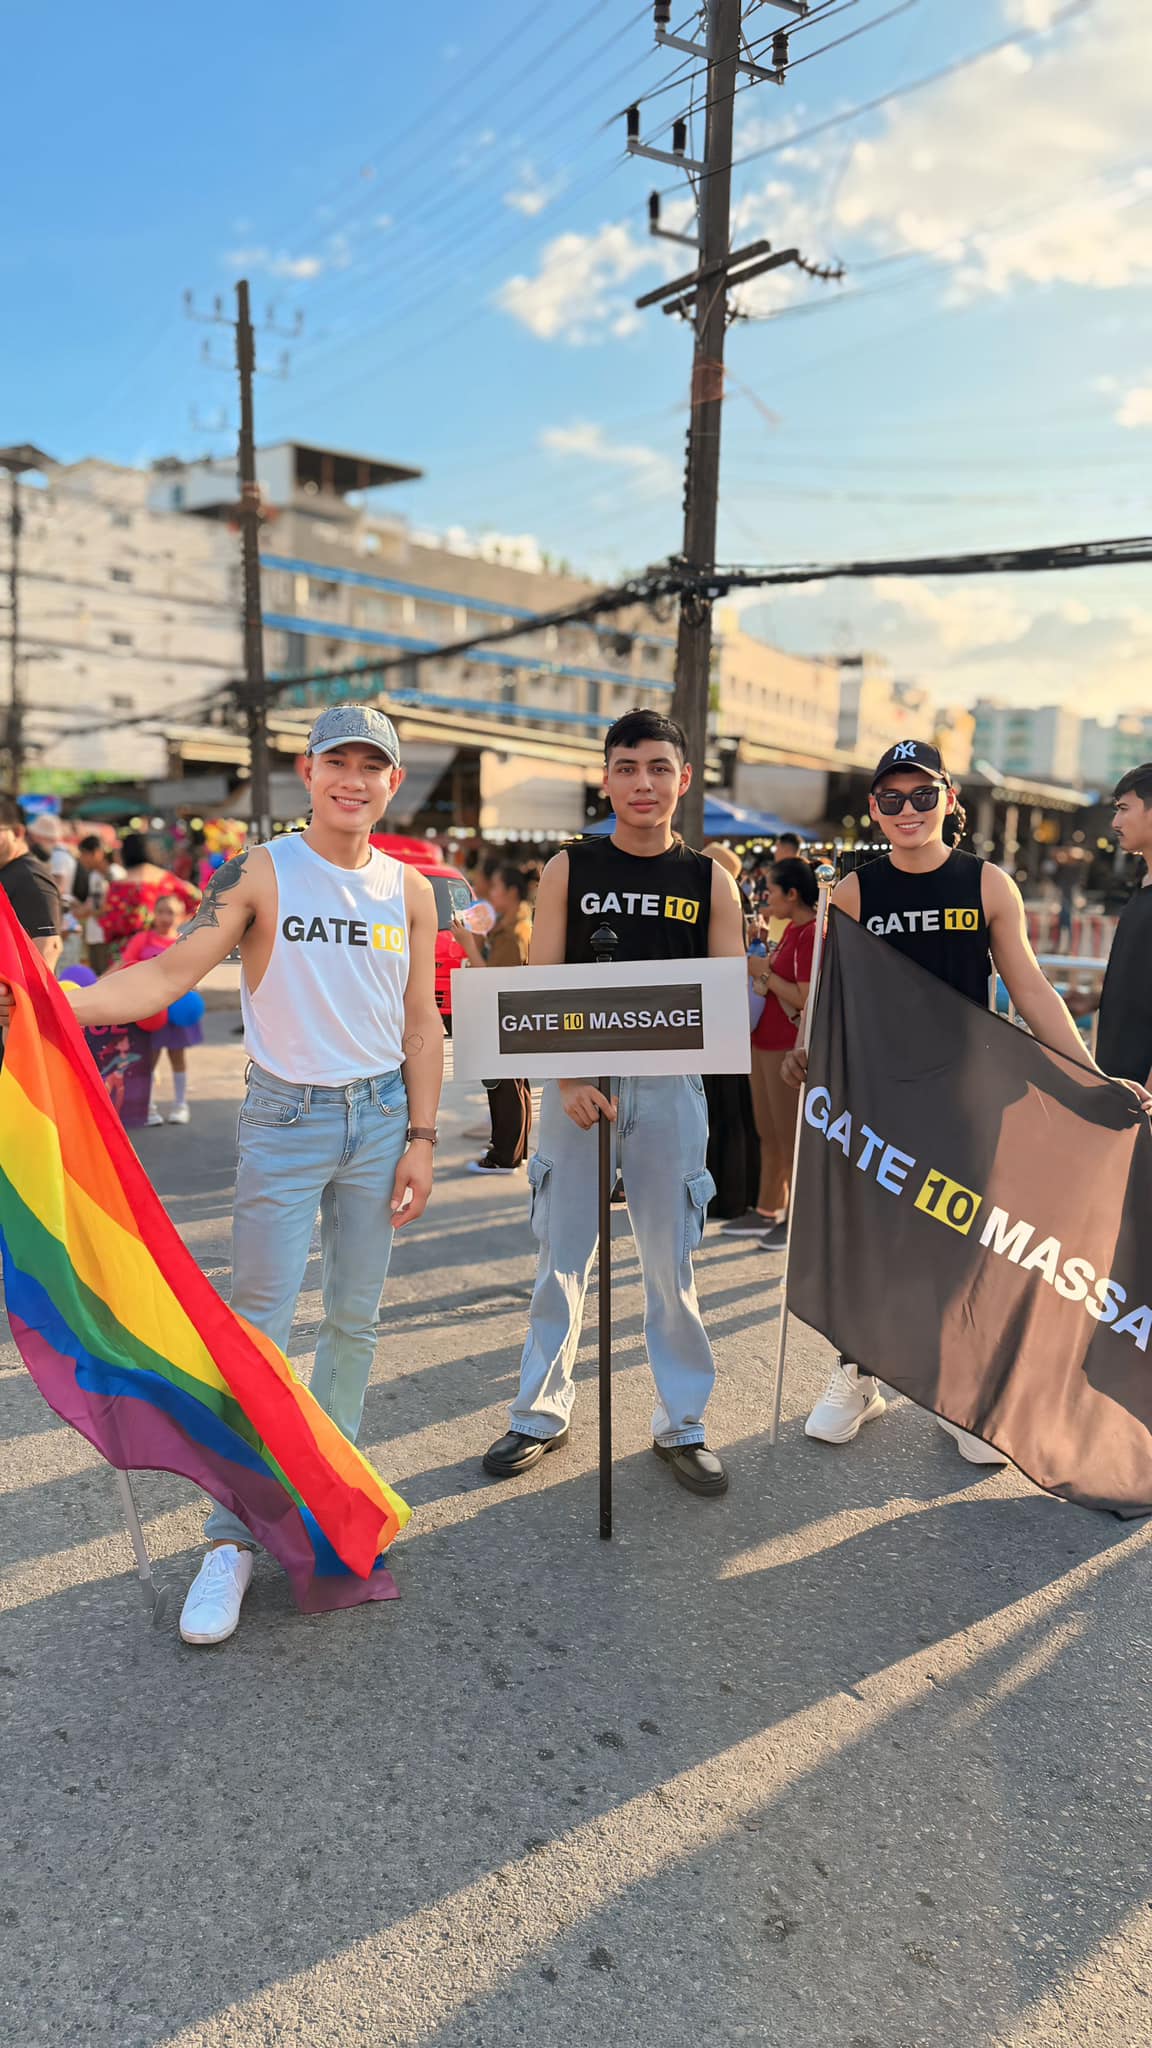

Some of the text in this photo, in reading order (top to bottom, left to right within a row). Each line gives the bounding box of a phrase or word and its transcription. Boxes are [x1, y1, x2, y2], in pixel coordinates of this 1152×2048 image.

[580, 892, 696, 920] GATE 10
[282, 915, 402, 950] GATE 10
[866, 910, 976, 936] GATE 10
[501, 1009, 701, 1032] GATE 10 MASSAGE
[804, 1086, 1152, 1352] GATE 10 MASSA
